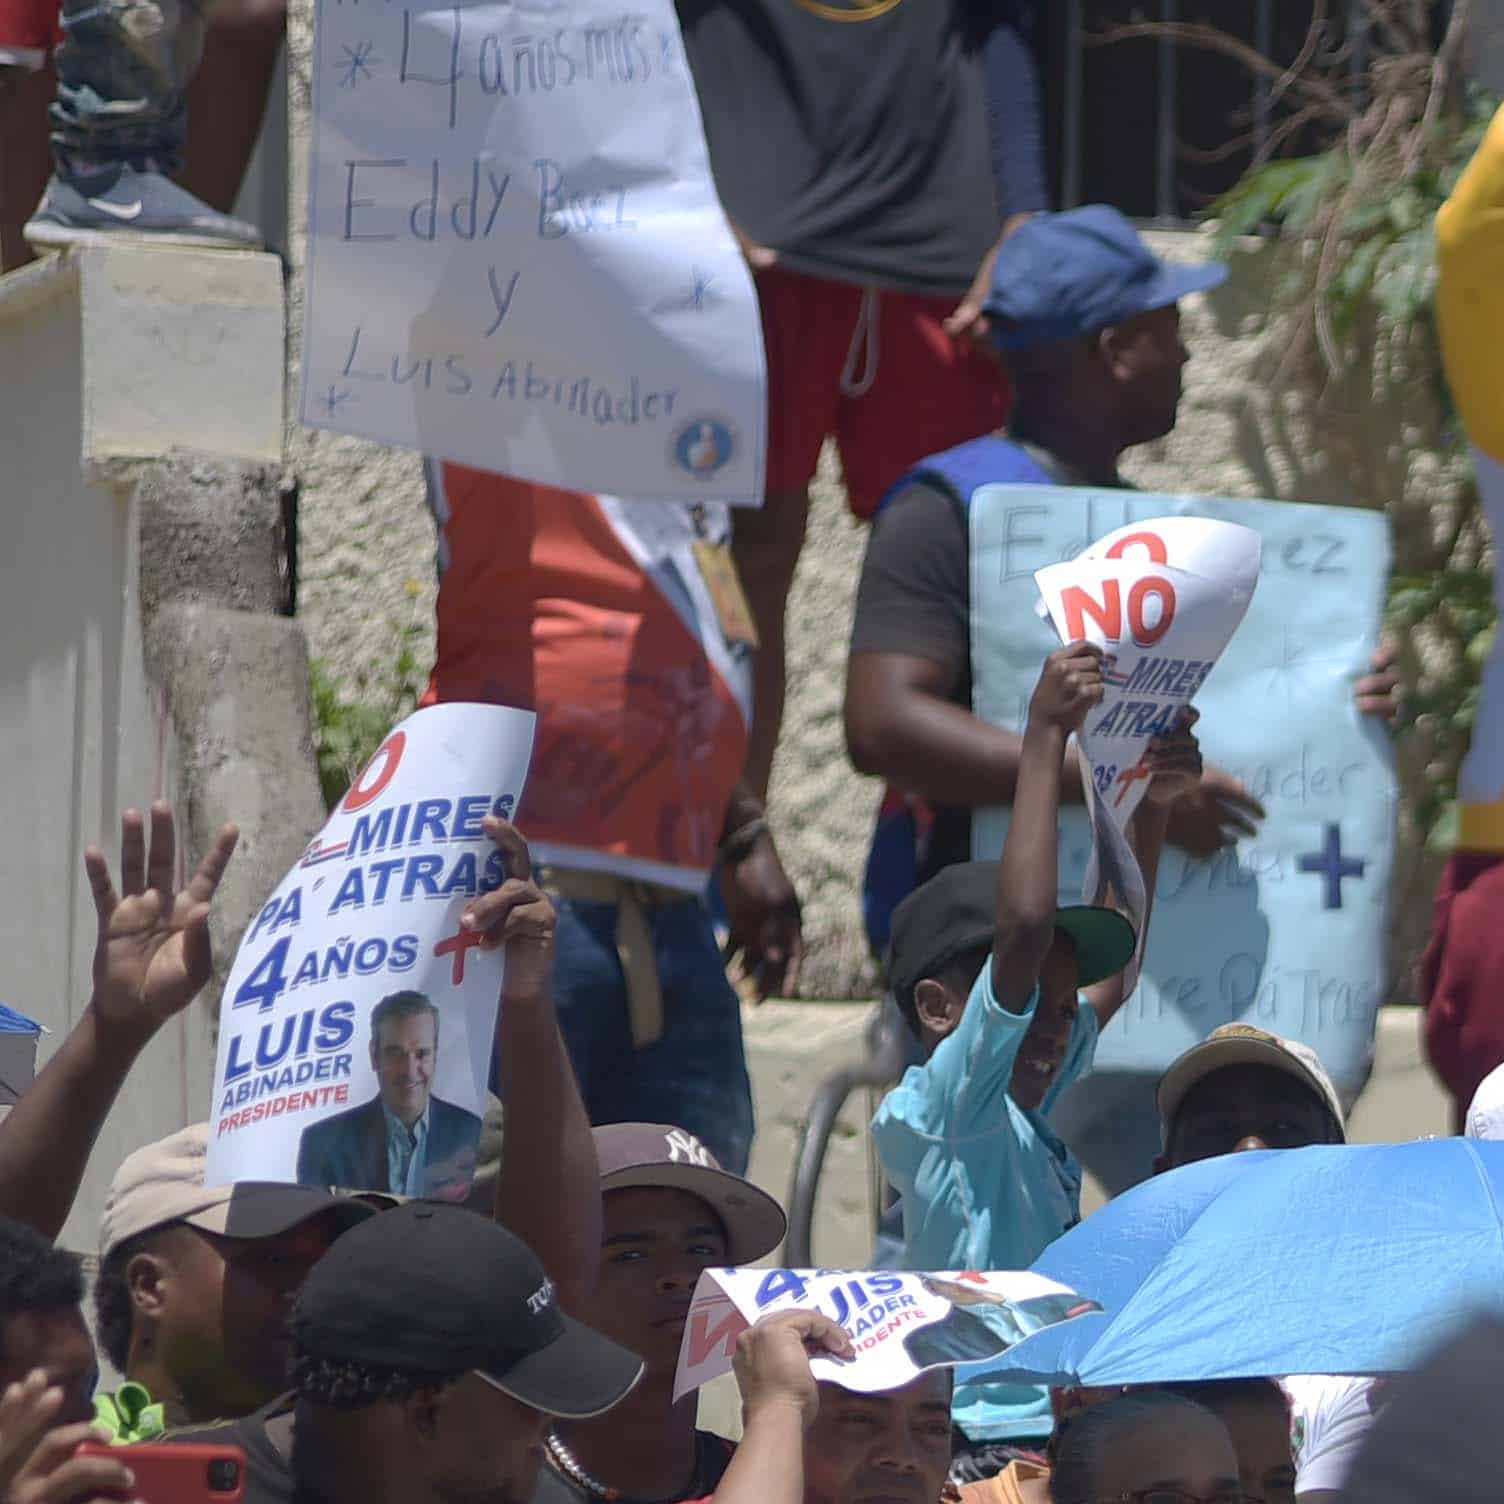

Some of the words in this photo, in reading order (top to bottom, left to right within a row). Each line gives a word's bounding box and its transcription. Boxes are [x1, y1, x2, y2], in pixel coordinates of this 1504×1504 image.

[1060, 575, 1177, 650] NO
[1090, 701, 1176, 738] ATRA
[343, 730, 407, 815] O
[345, 792, 515, 859] MIRES
[327, 852, 508, 917] ATRAS
[232, 935, 292, 1014] 4
[288, 934, 420, 991] AÑOS
[223, 1000, 356, 1087] LUIS
[217, 1083, 350, 1139] PRESIDENTE
[220, 1052, 353, 1117] ABINADER
